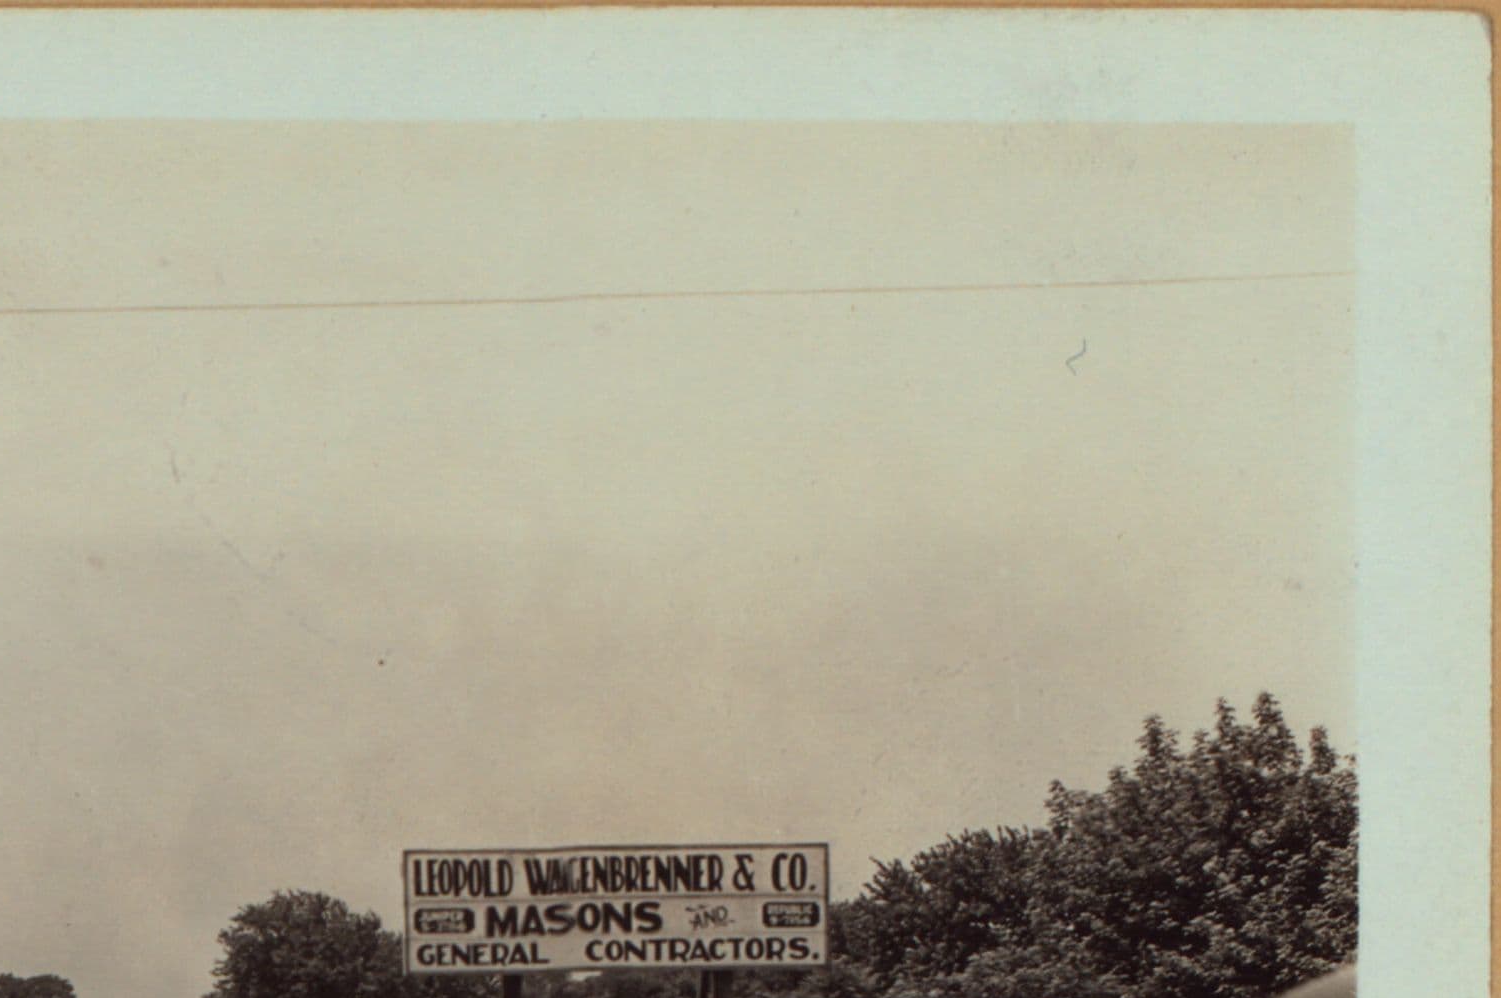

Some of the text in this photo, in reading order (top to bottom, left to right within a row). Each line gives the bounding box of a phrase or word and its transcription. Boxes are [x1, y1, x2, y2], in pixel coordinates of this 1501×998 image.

[414, 858, 513, 897] LEOPOLD
[732, 853, 756, 892] &
[771, 852, 816, 892] CO.
[485, 902, 663, 938] MASONS
[416, 937, 819, 966] GENERAL CONTRACTORS.
